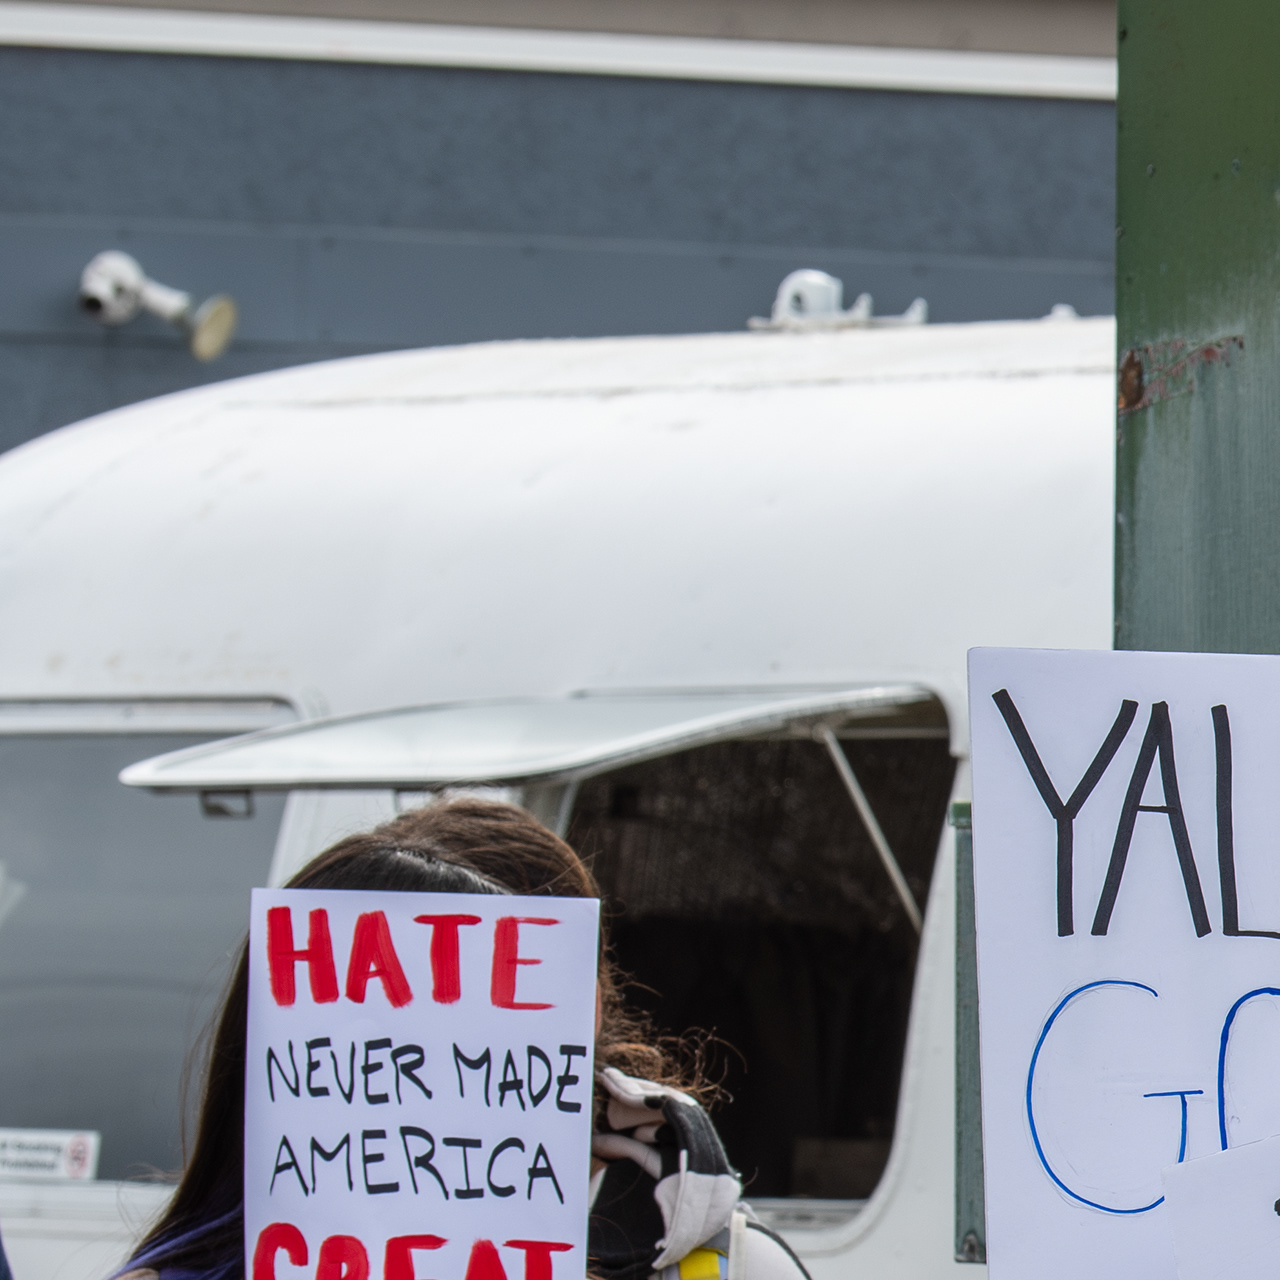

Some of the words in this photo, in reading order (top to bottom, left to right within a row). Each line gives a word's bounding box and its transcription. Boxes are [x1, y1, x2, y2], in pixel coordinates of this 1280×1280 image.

[266, 906, 562, 1011] HATE
[266, 1037, 433, 1105] NEVER
[452, 1043, 587, 1113] MADE
[270, 1126, 565, 1204] AMERICA
